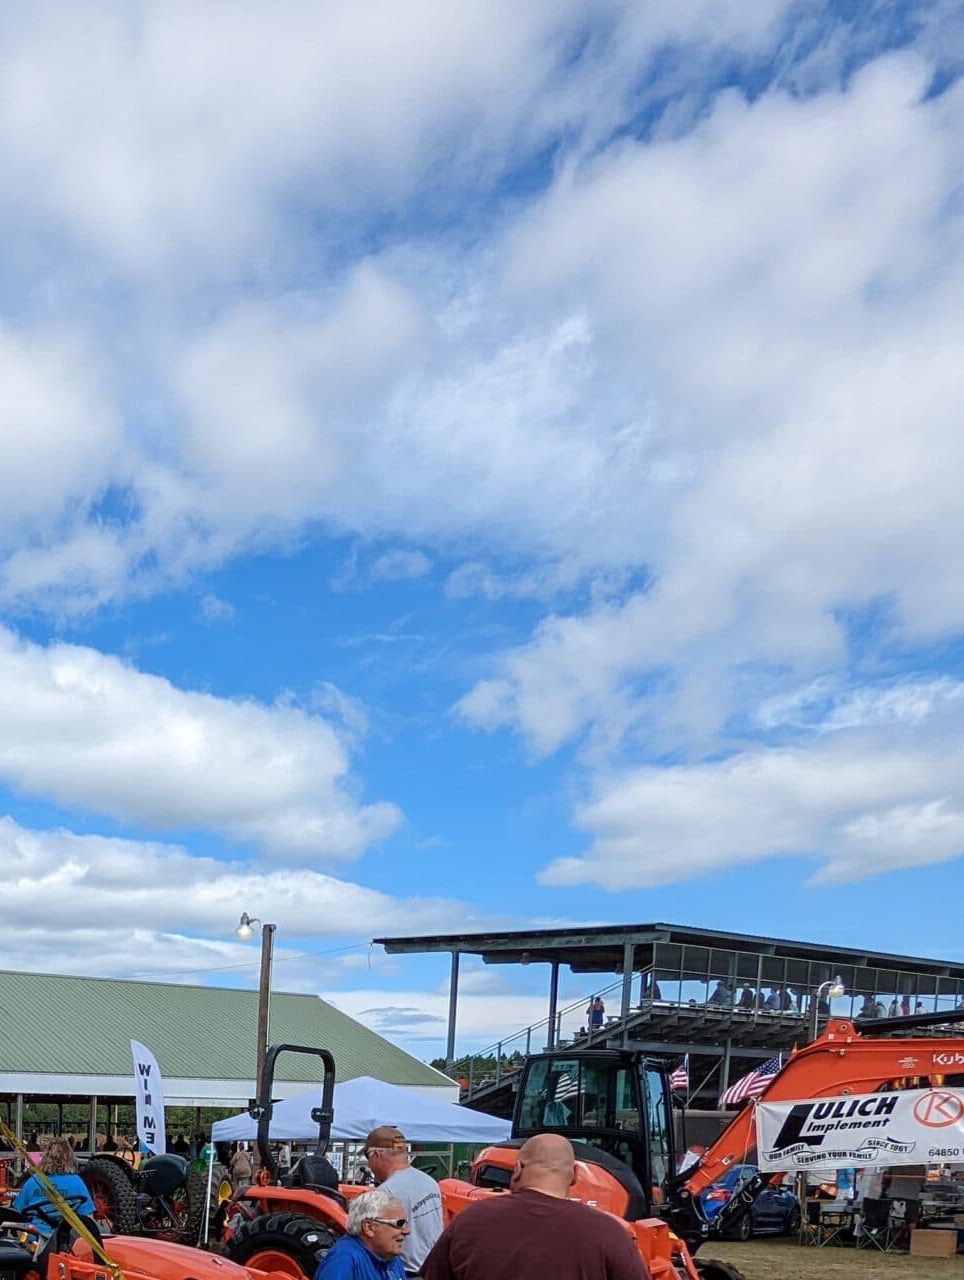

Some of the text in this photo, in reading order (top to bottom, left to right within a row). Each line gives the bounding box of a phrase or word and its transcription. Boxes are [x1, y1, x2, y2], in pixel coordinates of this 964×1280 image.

[806, 1117, 891, 1134] Implement
[768, 1143, 806, 1160] OUR FAMILY
[796, 1152, 827, 1163] SERVING
[828, 1151, 848, 1160] YOUR
[928, 1148, 960, 1158] 64850
